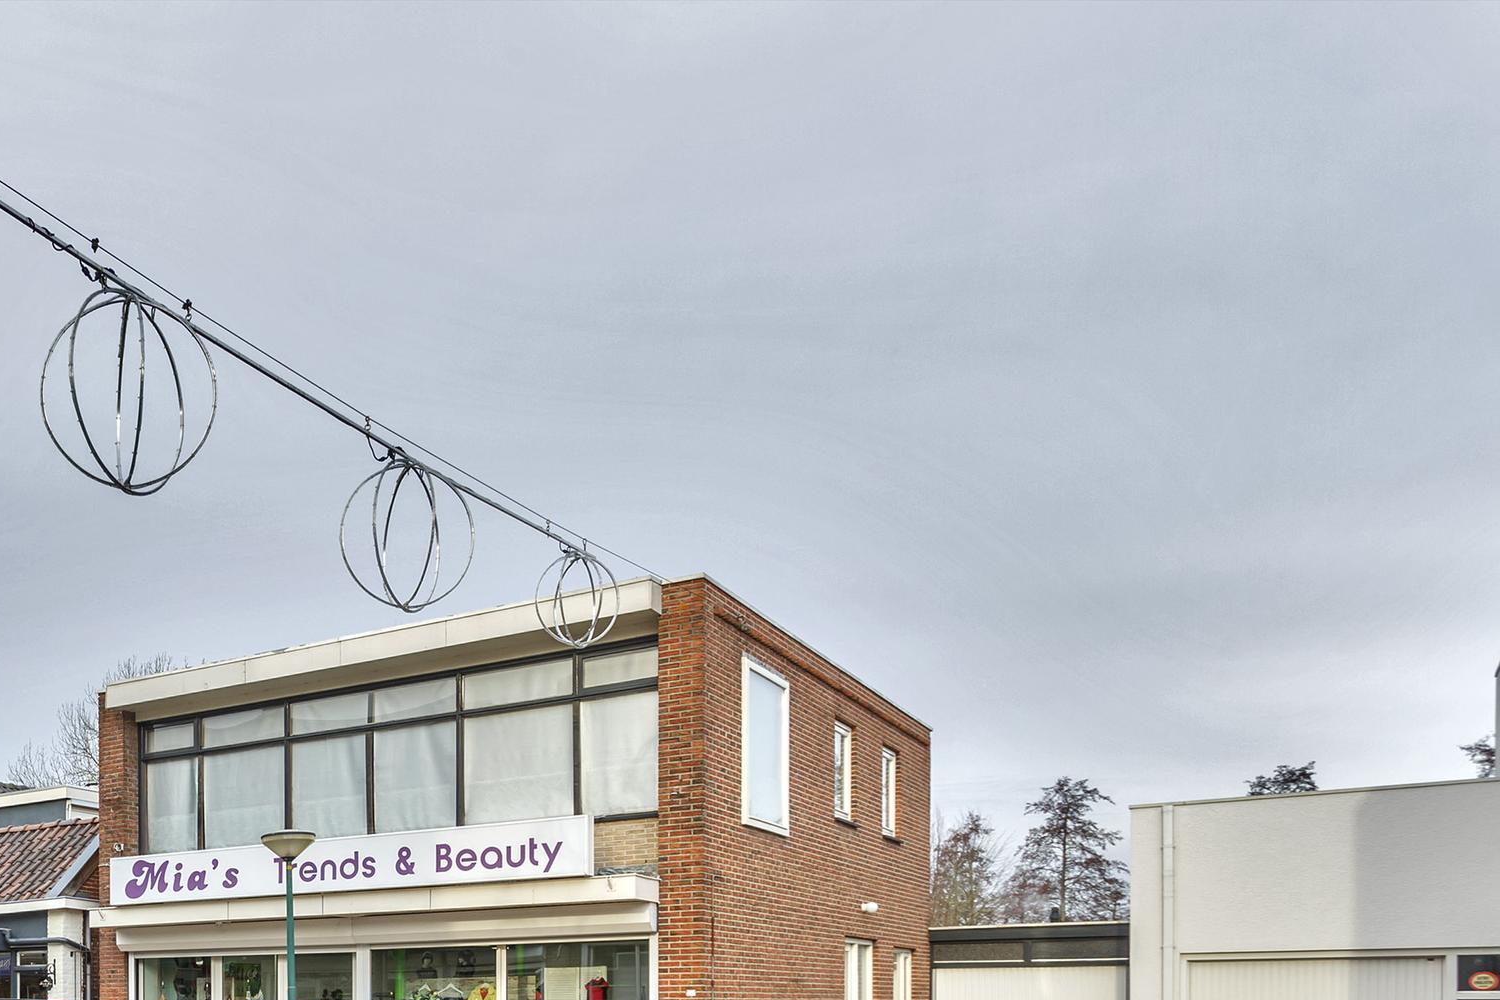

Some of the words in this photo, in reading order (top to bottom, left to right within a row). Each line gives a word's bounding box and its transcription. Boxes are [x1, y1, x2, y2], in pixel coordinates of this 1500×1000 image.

[125, 858, 239, 899] Mia's
[395, 847, 415, 875] &
[435, 838, 563, 873] Beauty
